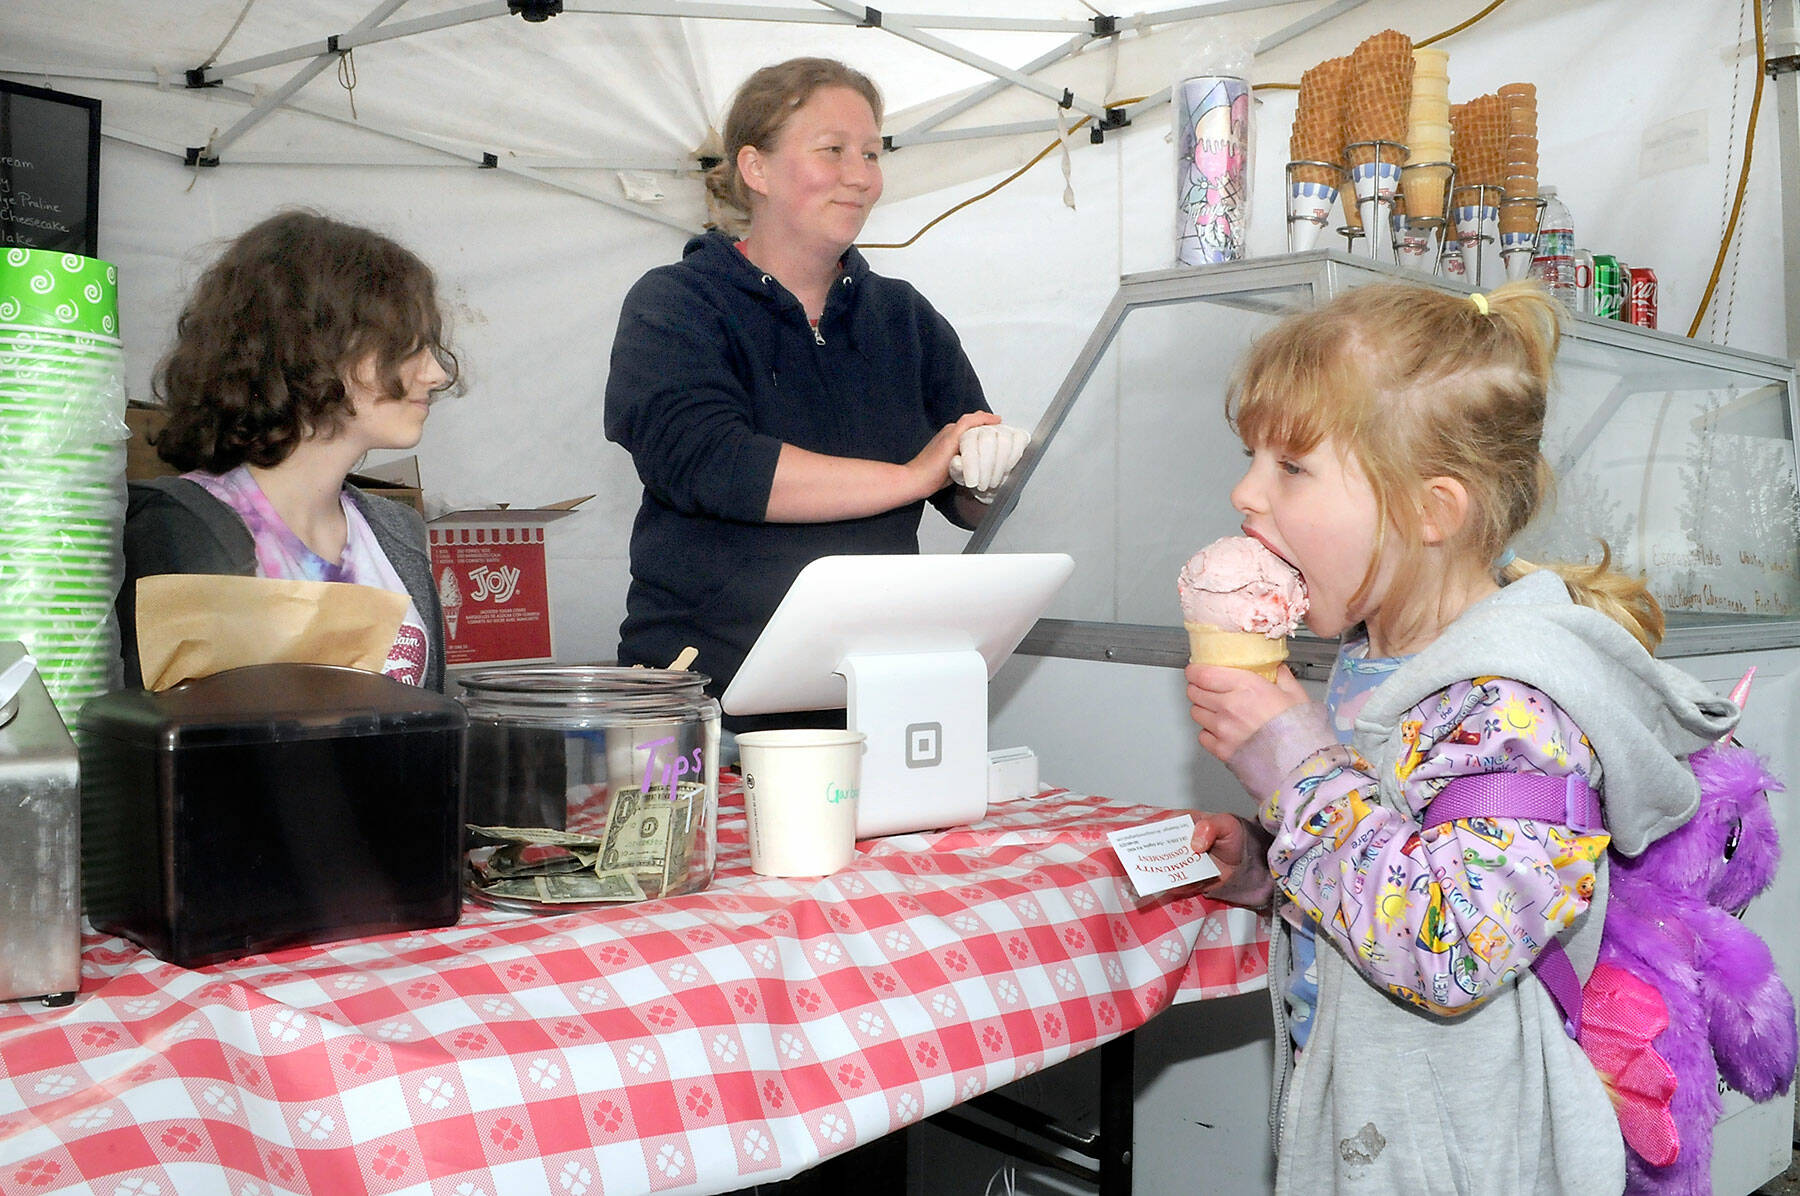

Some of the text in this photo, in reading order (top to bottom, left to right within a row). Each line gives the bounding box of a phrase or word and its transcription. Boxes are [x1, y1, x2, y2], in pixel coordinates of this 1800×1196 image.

[635, 735, 702, 803] Tips
[1135, 851, 1202, 873] COMMUNITY
[1436, 866, 1479, 920] DOWN
